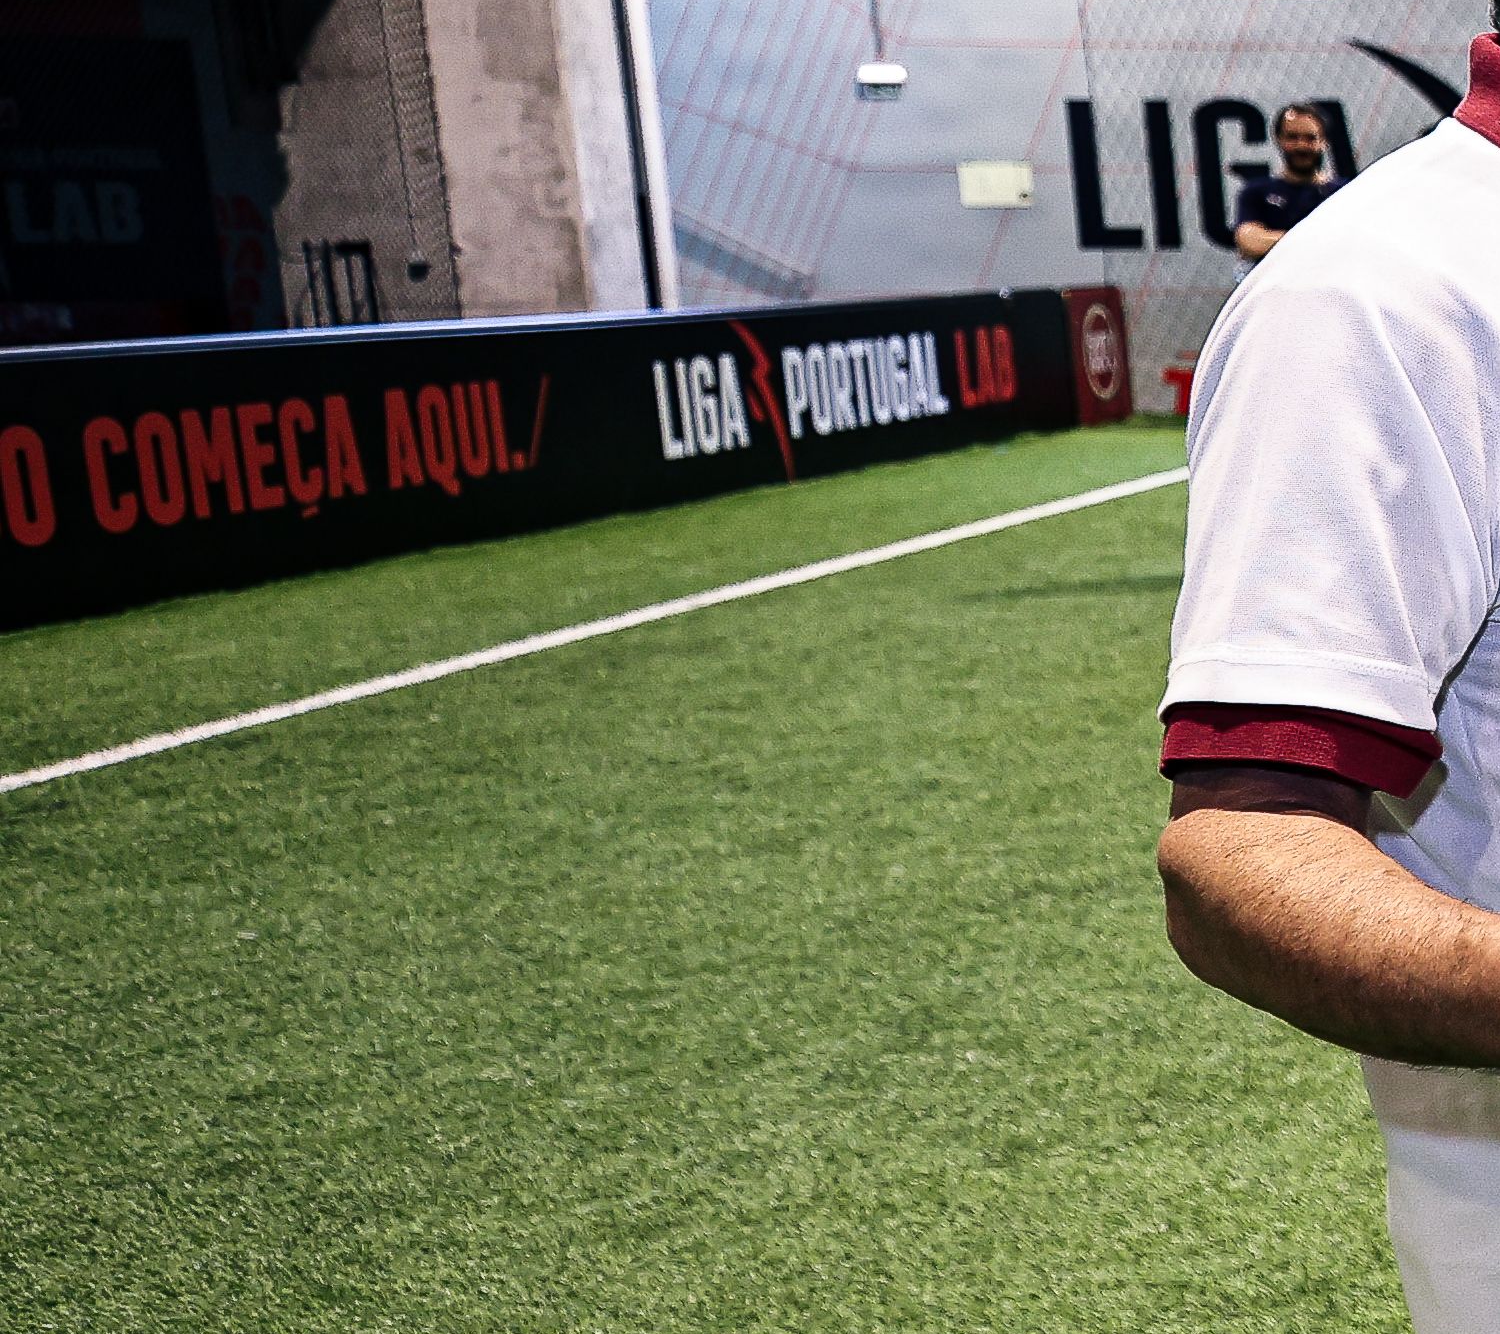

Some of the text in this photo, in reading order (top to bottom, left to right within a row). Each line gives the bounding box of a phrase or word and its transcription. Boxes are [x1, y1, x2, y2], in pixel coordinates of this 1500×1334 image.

[653, 352, 751, 462] LIGA
[781, 329, 951, 440] PORTUGAL
[954, 323, 1019, 410] LAB
[82, 392, 368, 535] COMEÇA
